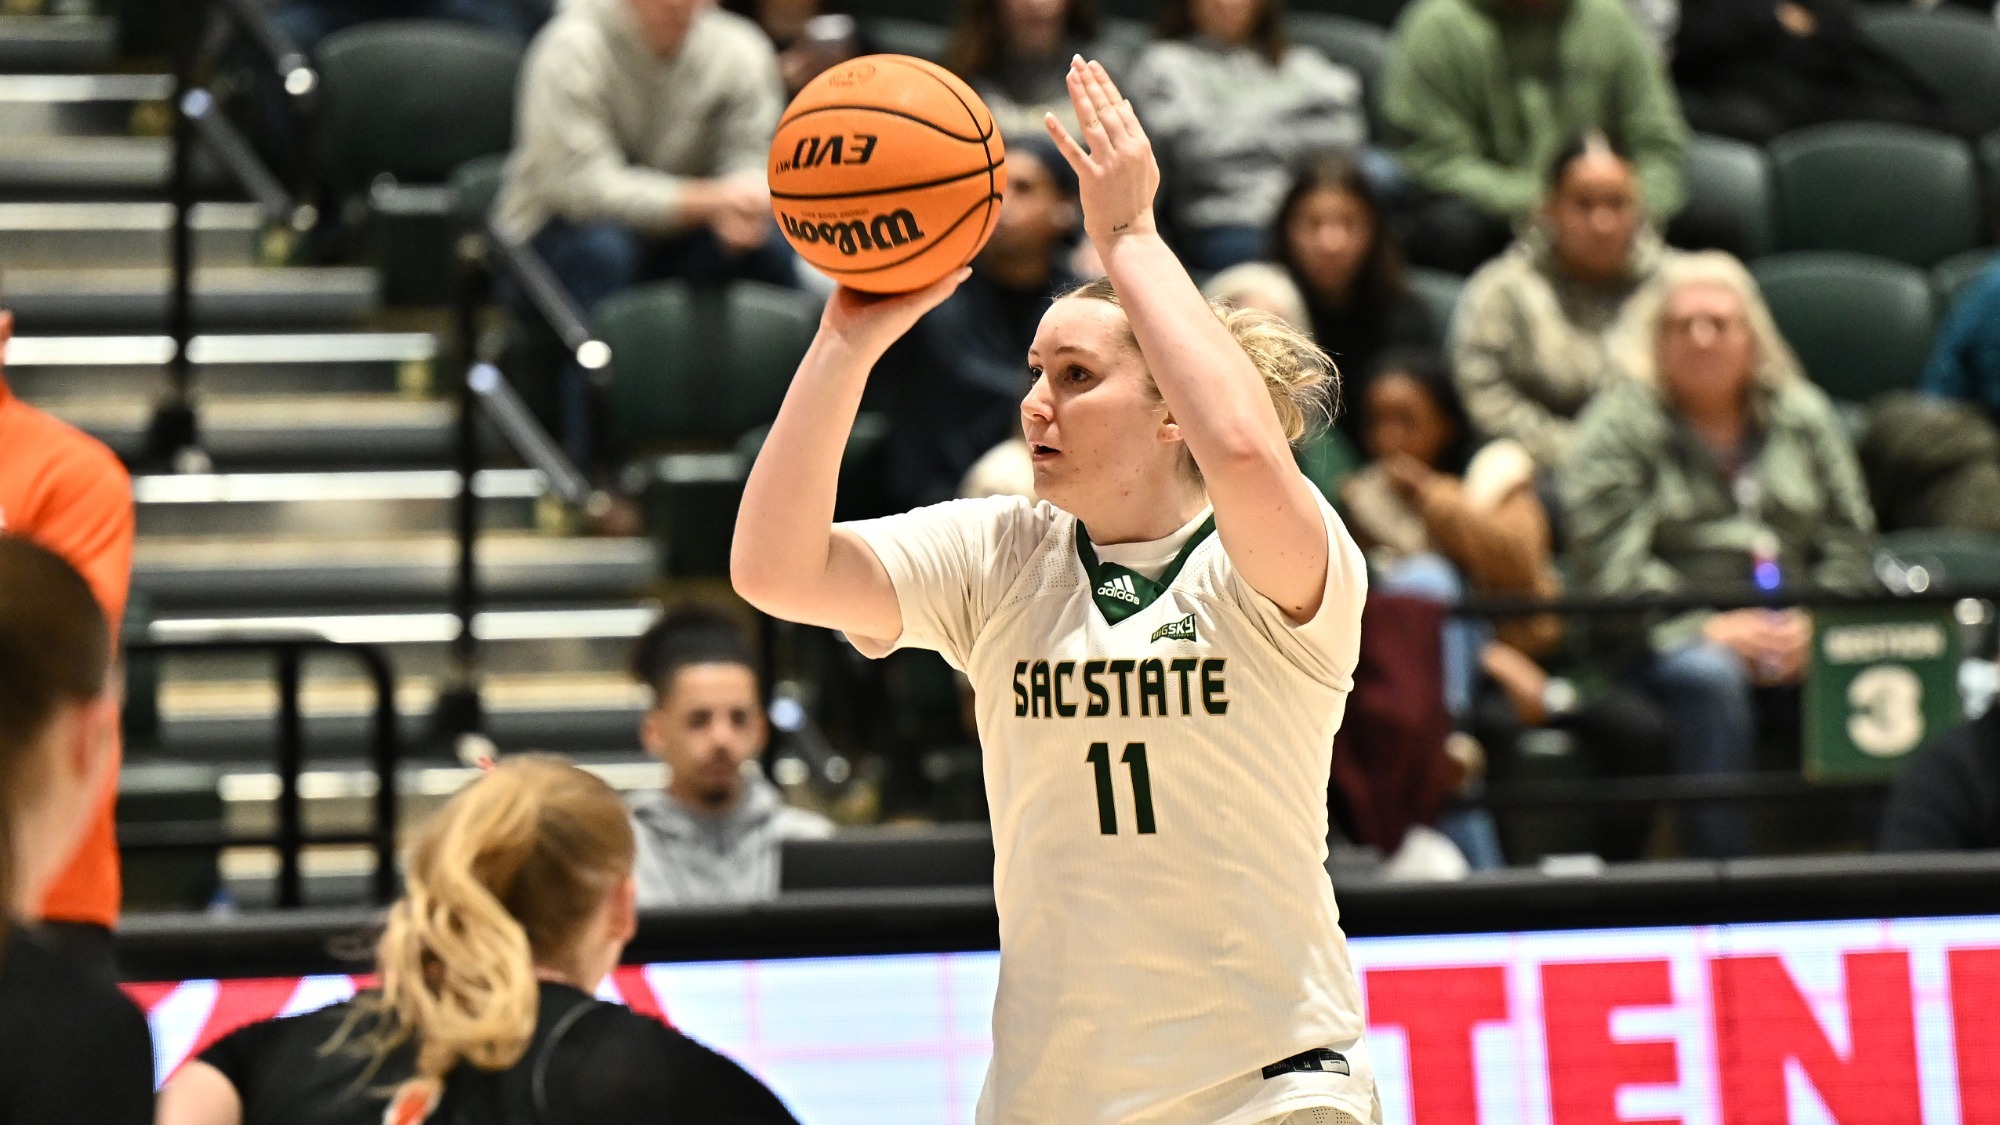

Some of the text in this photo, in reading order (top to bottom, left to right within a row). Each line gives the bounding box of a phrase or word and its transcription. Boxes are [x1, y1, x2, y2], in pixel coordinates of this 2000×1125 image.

[792, 133, 878, 170] EVO
[781, 208, 925, 258] Wilson
[1097, 585, 1140, 606] adidas
[1012, 657, 1230, 718] SAC STATE
[1847, 664, 1926, 758] 3
[1085, 741, 1157, 836] 11
